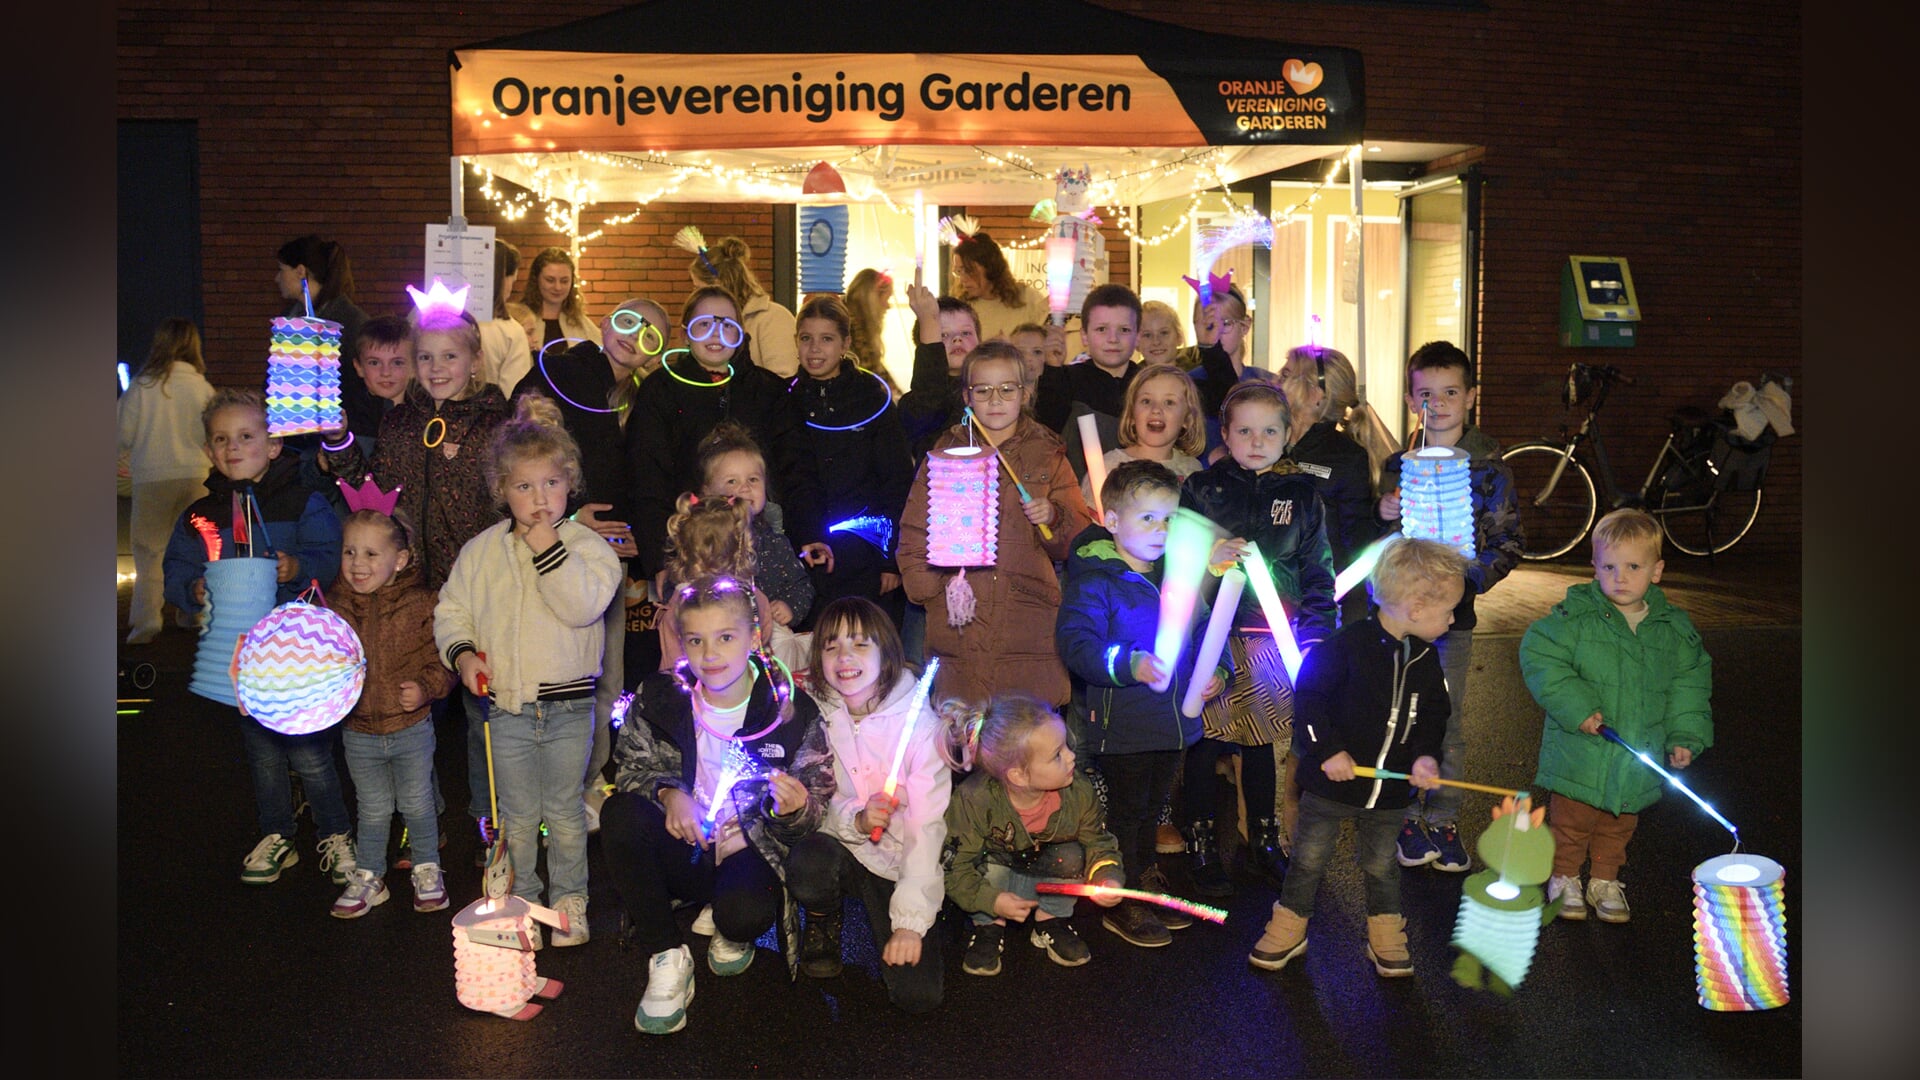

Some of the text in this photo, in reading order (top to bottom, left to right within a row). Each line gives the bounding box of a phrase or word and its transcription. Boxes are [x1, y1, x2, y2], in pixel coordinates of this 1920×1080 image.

[1218, 80, 1286, 96] ORANJE
[492, 71, 1131, 126] Oranjevereniging Garderen
[1226, 97, 1328, 113] VERENIGING
[1236, 115, 1327, 130] GARDEREN
